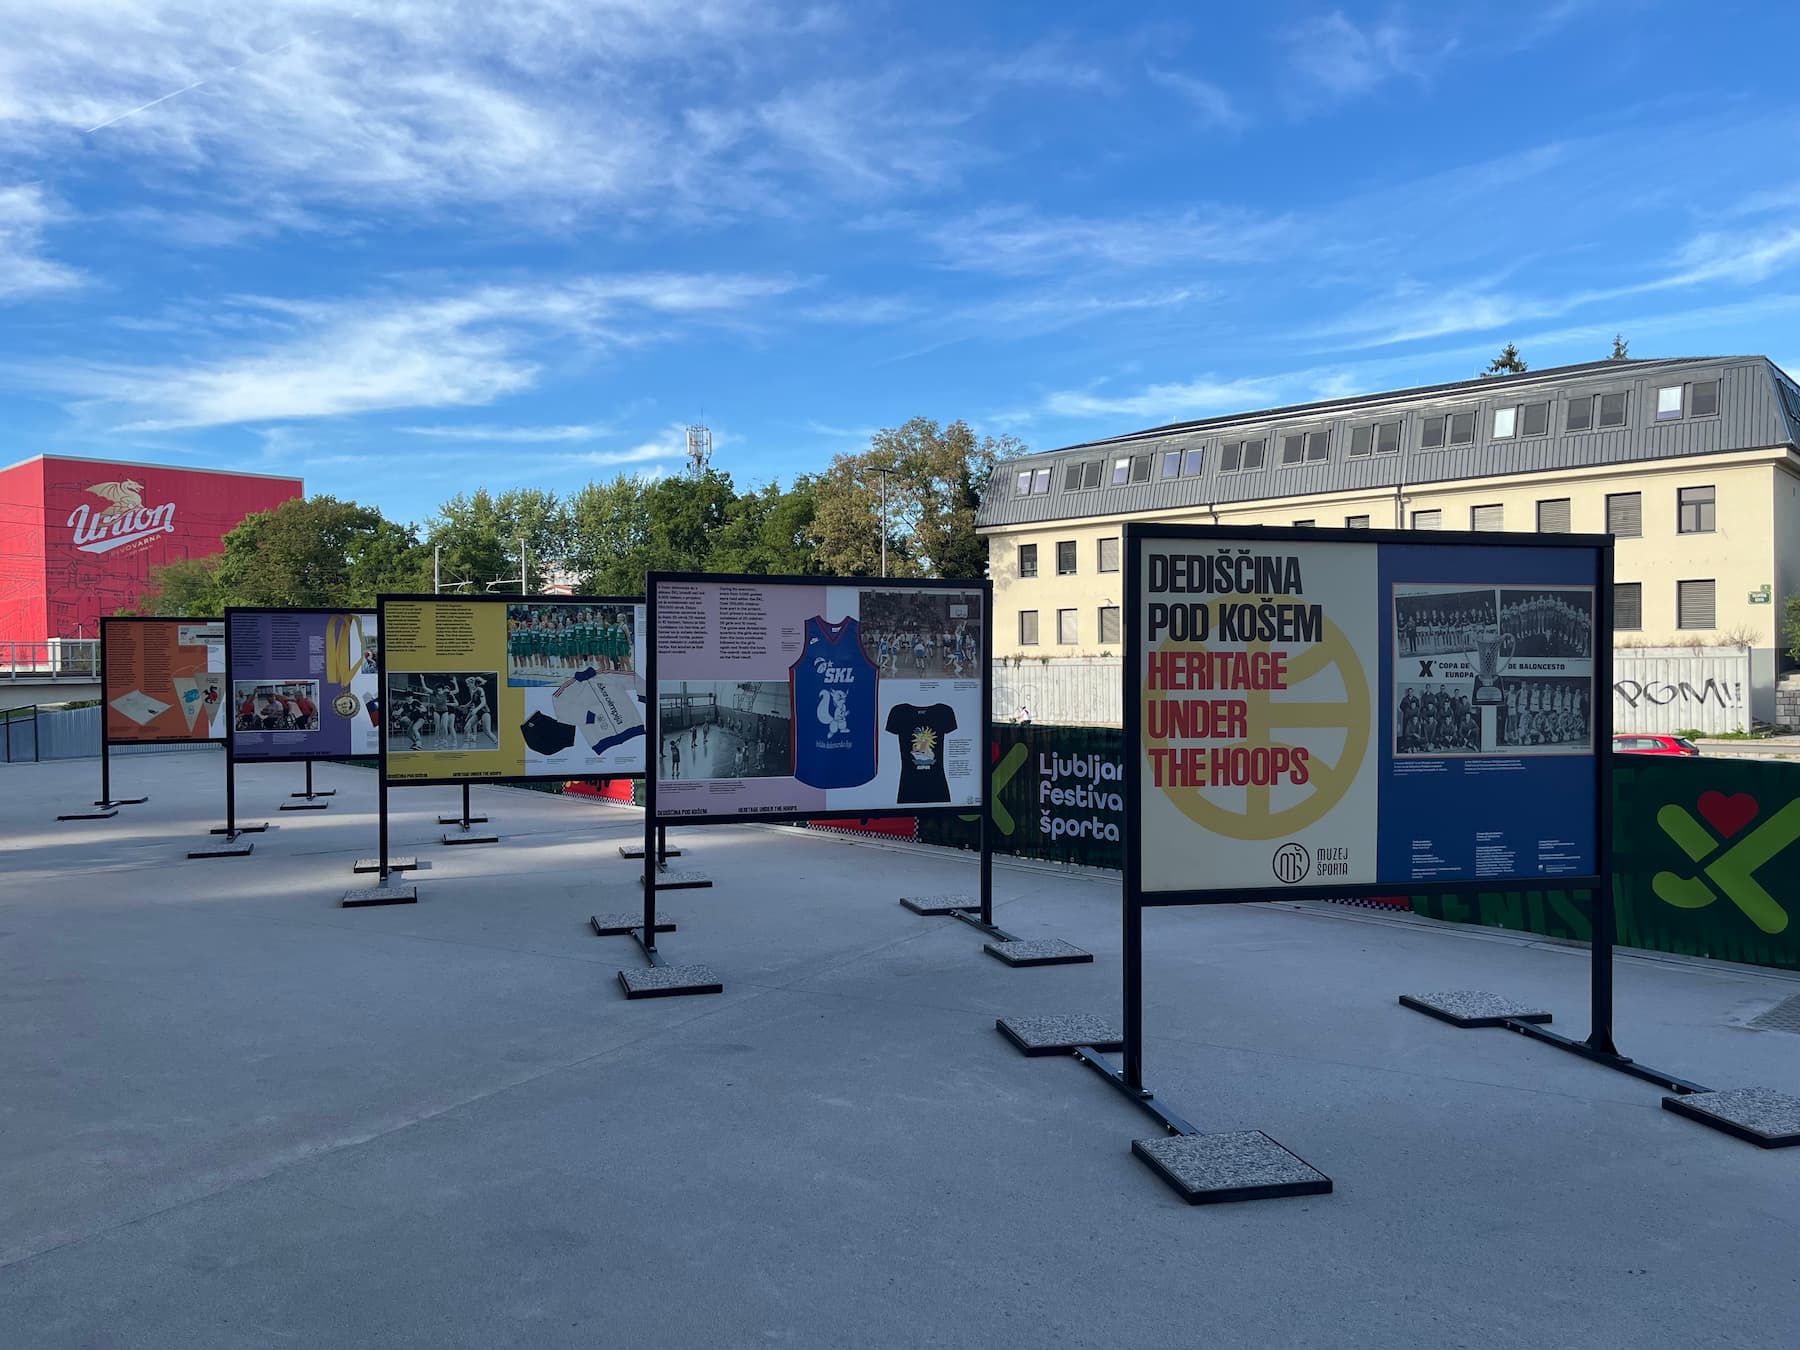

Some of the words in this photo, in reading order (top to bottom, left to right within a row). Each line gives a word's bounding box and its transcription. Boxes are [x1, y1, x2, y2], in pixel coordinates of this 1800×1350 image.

[67, 502, 175, 545] Union
[1148, 548, 1303, 594] DEDIŠČINA
[1148, 602, 1209, 642] POD
[1219, 597, 1322, 642] KOŠEM
[1148, 651, 1287, 690] HERITAGE
[1148, 700, 1247, 738] UNDER
[1148, 748, 1206, 787] THE
[1211, 747, 1309, 786] HOOPS
[1039, 809, 1120, 841] športa
[1317, 848, 1348, 861] MUZEJ
[1317, 861, 1348, 876] ŠPORTA
